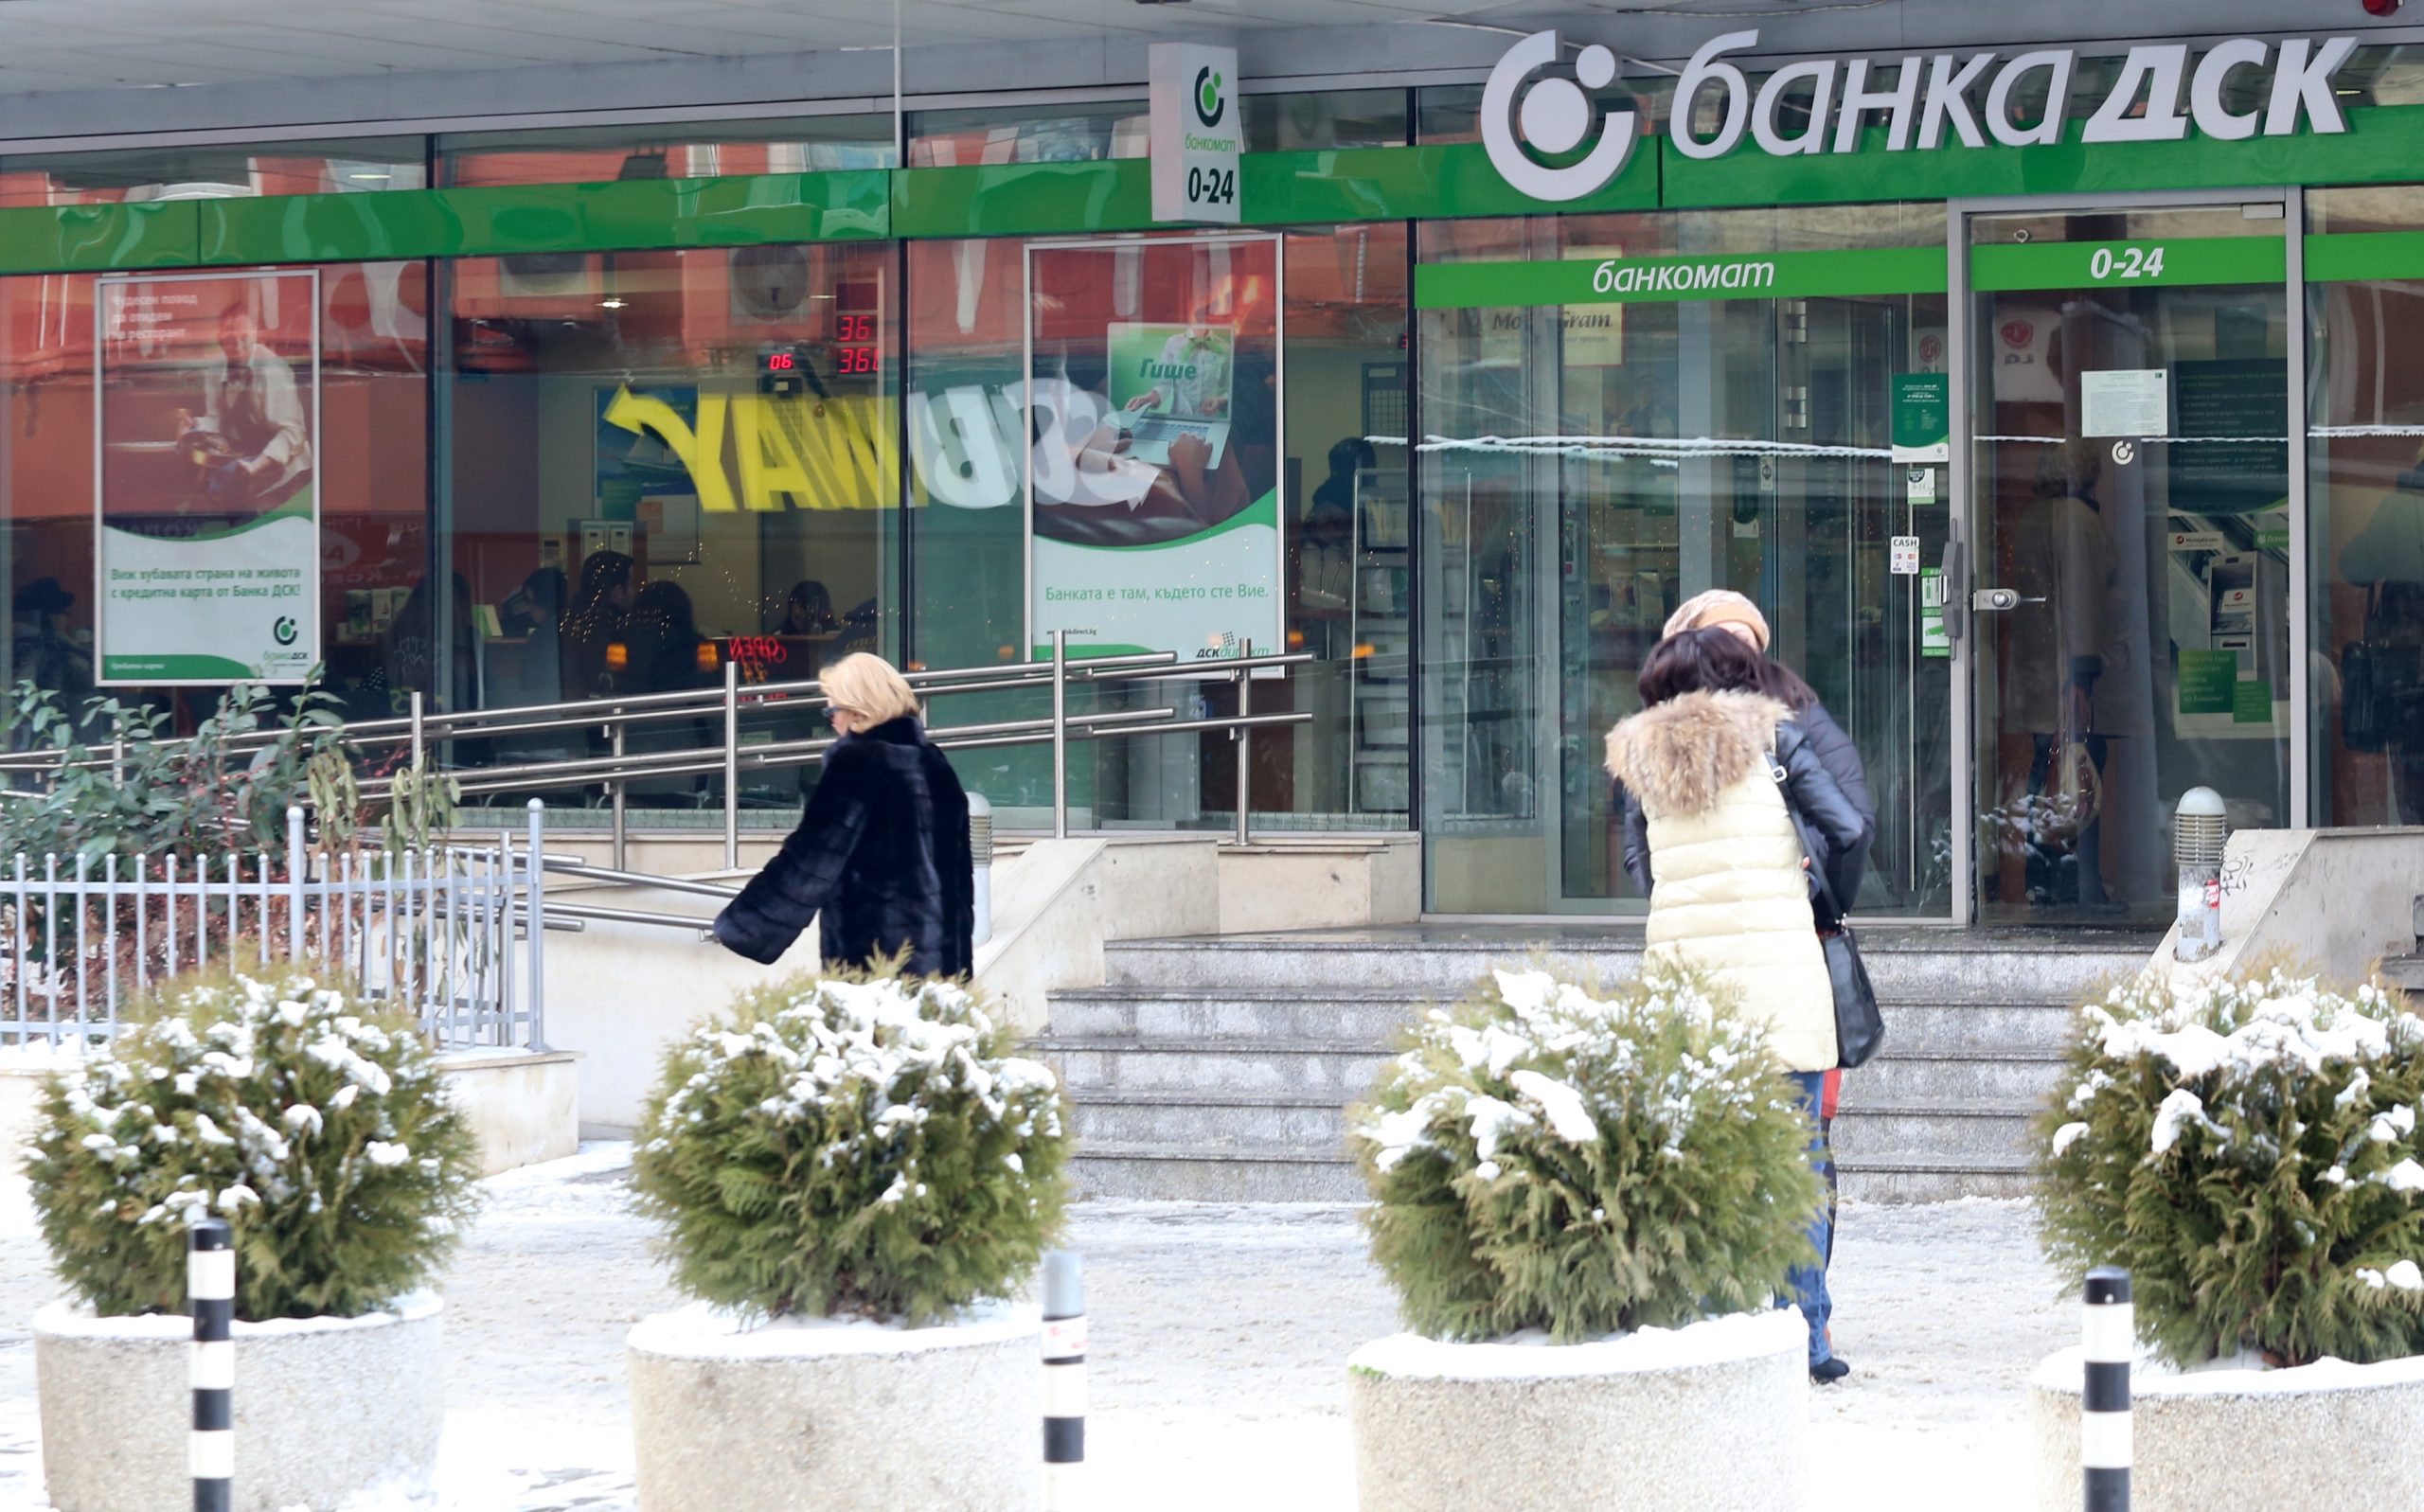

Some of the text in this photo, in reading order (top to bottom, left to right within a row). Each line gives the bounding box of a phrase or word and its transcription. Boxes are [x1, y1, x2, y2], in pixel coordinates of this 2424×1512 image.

[1185, 132, 1237, 152] банкомат
[1187, 166, 1235, 205] 0-24
[2090, 246, 2166, 280] 0-24
[1592, 259, 1775, 294] банкомат
[769, 353, 793, 371] 06
[1139, 357, 1198, 380] Гише
[1893, 538, 1917, 547] CASH
[110, 566, 301, 583] Виж хубавата страна на живота
[120, 587, 177, 601] кредитна
[180, 586, 213, 601] карта
[216, 586, 230, 597] от
[232, 585, 269, 597] Банка
[1045, 583, 1270, 602] Банката е там, където сте Вие.
